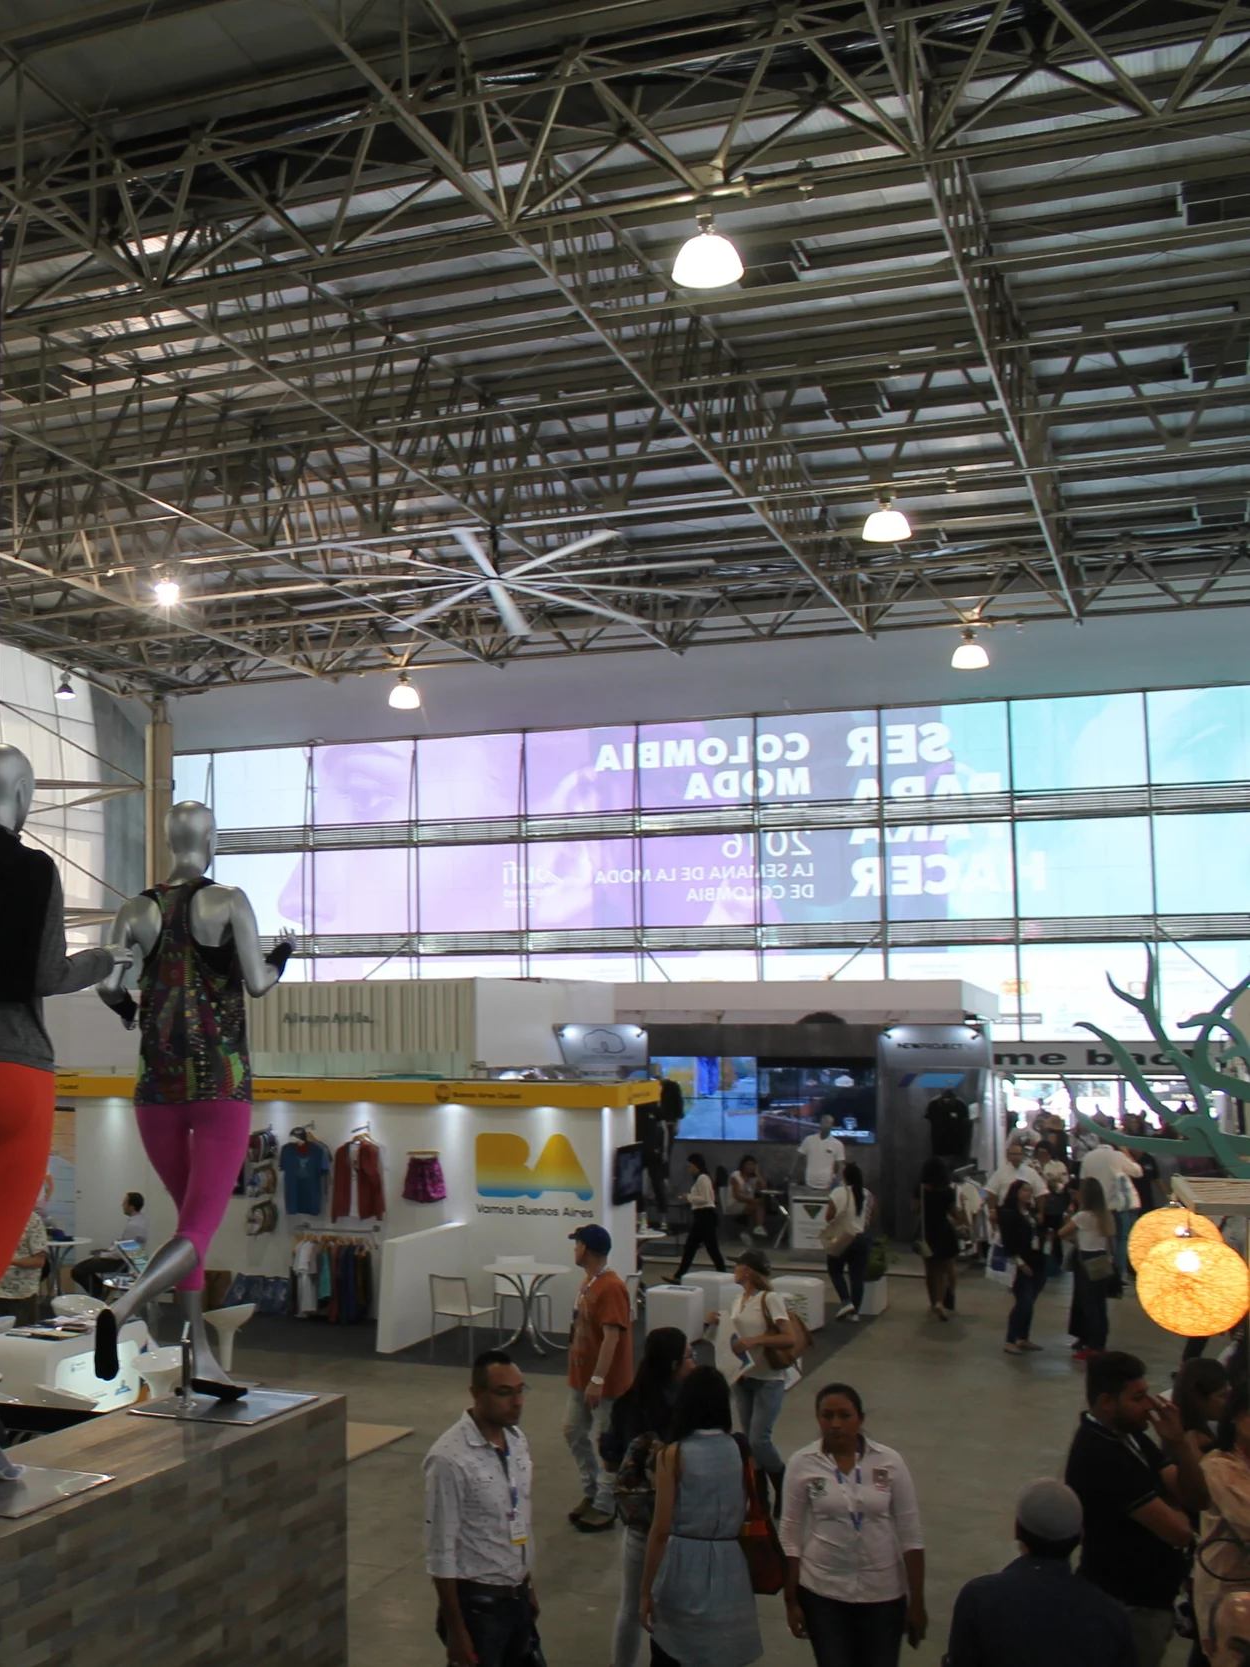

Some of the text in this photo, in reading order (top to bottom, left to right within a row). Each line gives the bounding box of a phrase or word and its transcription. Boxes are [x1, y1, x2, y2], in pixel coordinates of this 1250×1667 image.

[475, 1203, 594, 1218] Vamos Buenos Aires
